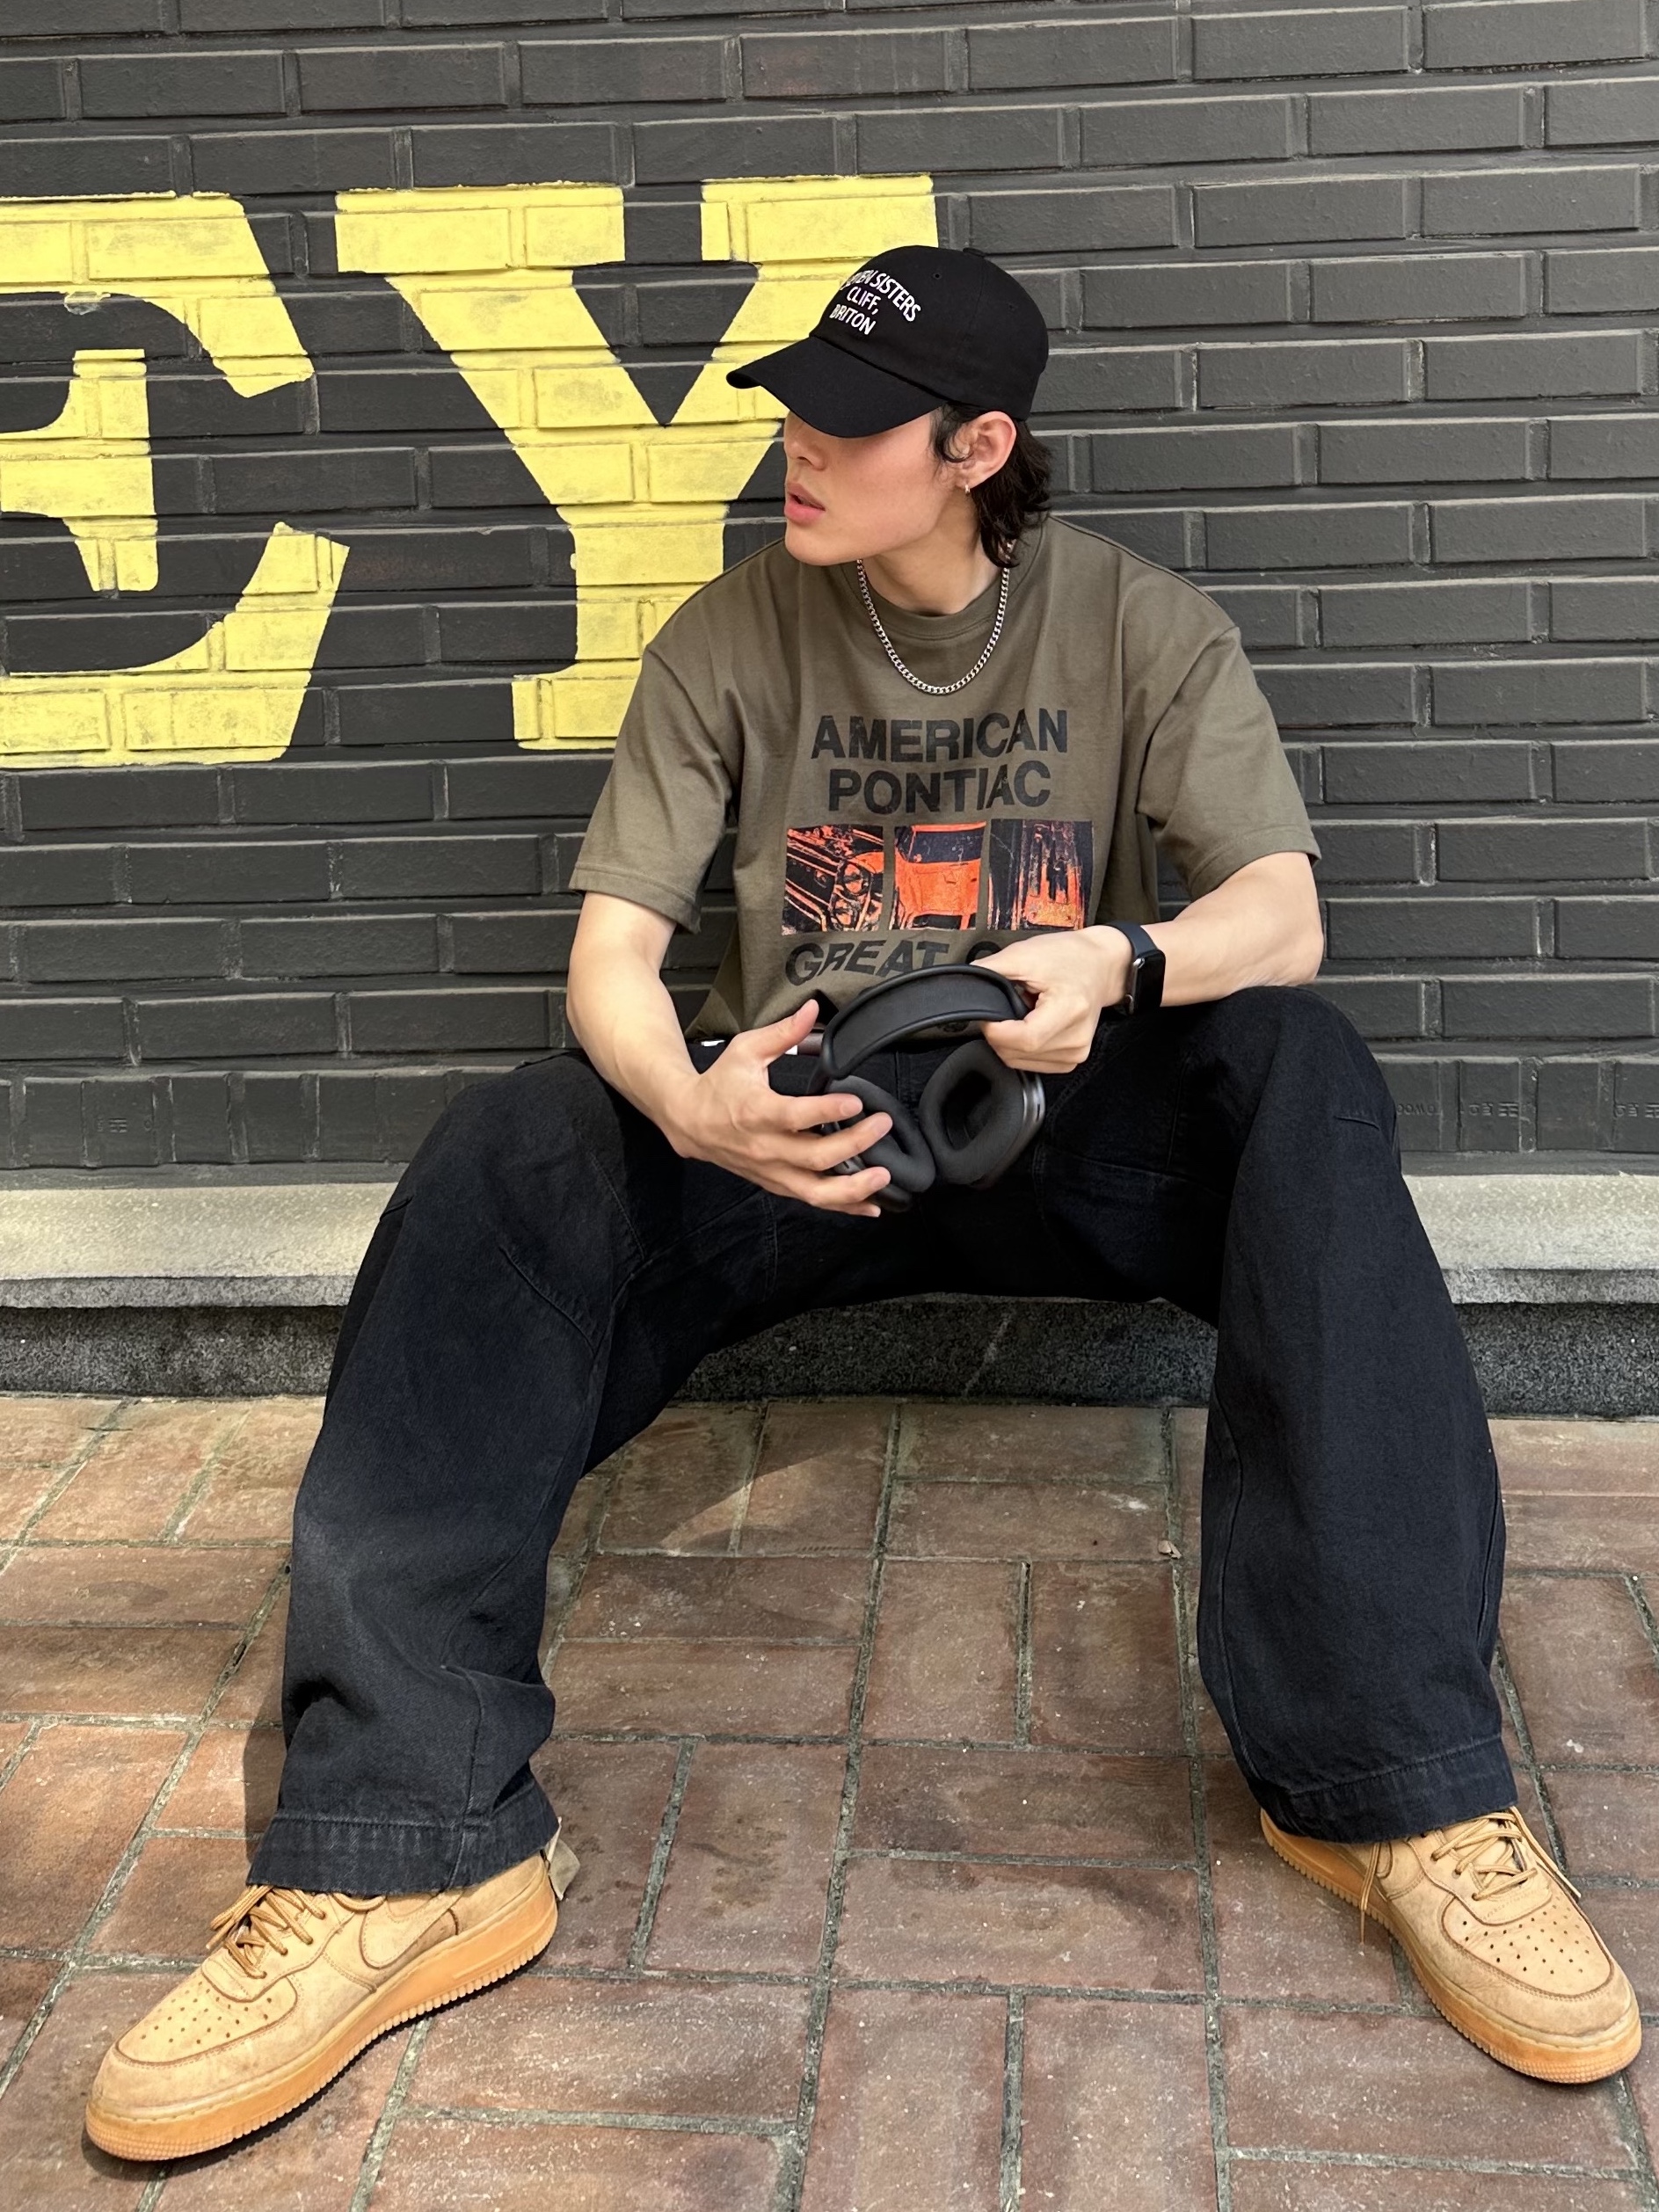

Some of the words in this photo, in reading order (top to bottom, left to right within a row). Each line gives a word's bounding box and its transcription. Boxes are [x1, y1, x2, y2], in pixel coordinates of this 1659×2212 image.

[829, 303, 877, 335] BRITON
[846, 286, 882, 315] CLIFF,
[869, 273, 921, 322] SISTERS
[811, 708, 1068, 763] AMERICAN
[828, 760, 1051, 815] PONTIAC
[785, 939, 950, 986] GREAT
